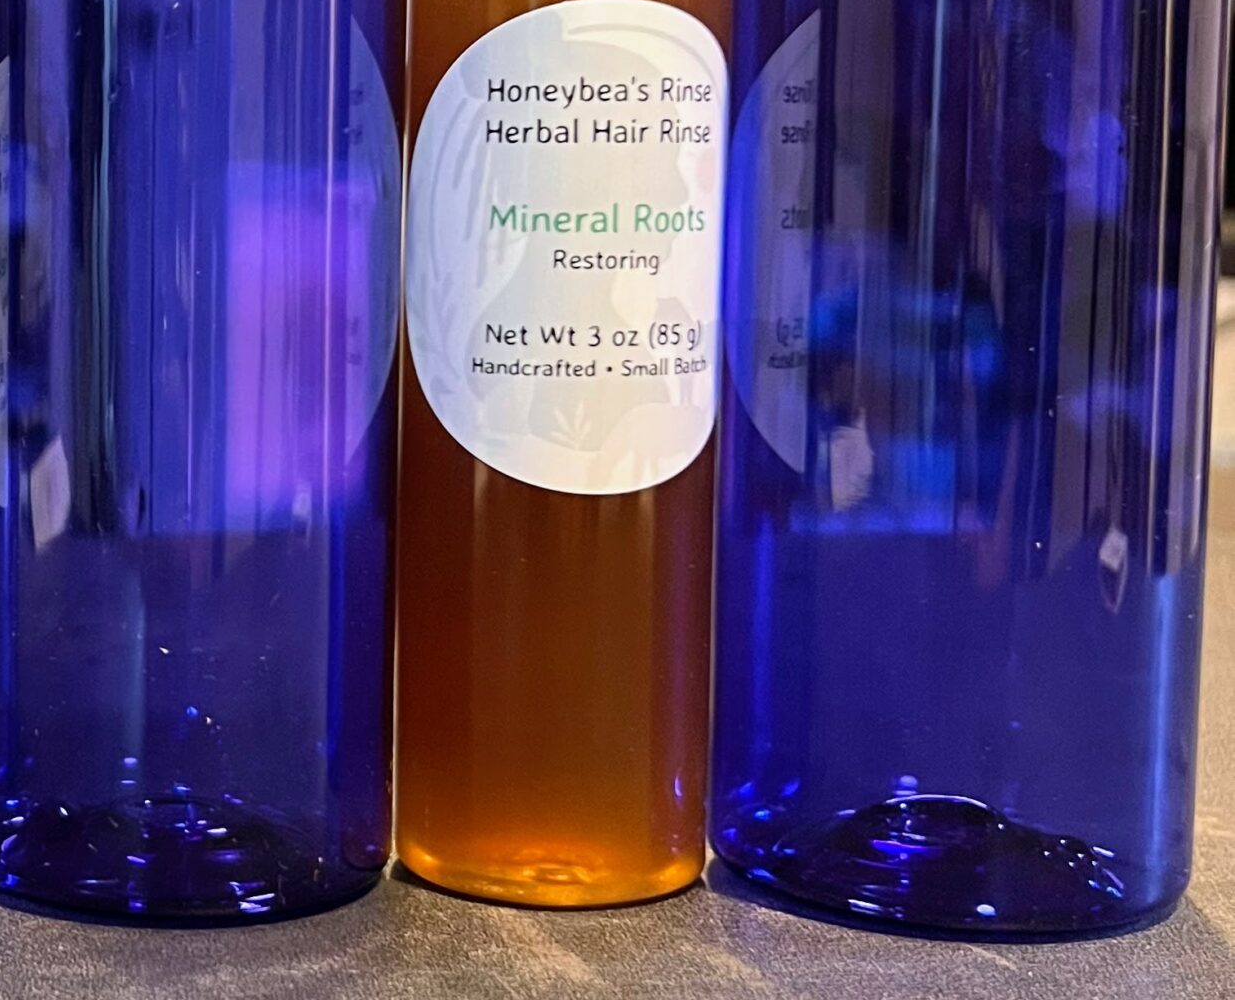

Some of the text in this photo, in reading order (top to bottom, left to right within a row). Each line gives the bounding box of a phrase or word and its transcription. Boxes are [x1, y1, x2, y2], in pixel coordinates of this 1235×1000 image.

[487, 77, 712, 108] Honeybea's Rinse
[486, 119, 710, 143] Herbal Hair Rinse
[489, 203, 705, 233] Mineral Roots
[553, 249, 660, 275] Restoring
[485, 321, 702, 351] Net Wt 3 oz (85 g)
[472, 357, 596, 377] Handcrafted
[621, 359, 668, 376] Small
[674, 357, 706, 374] Batch
